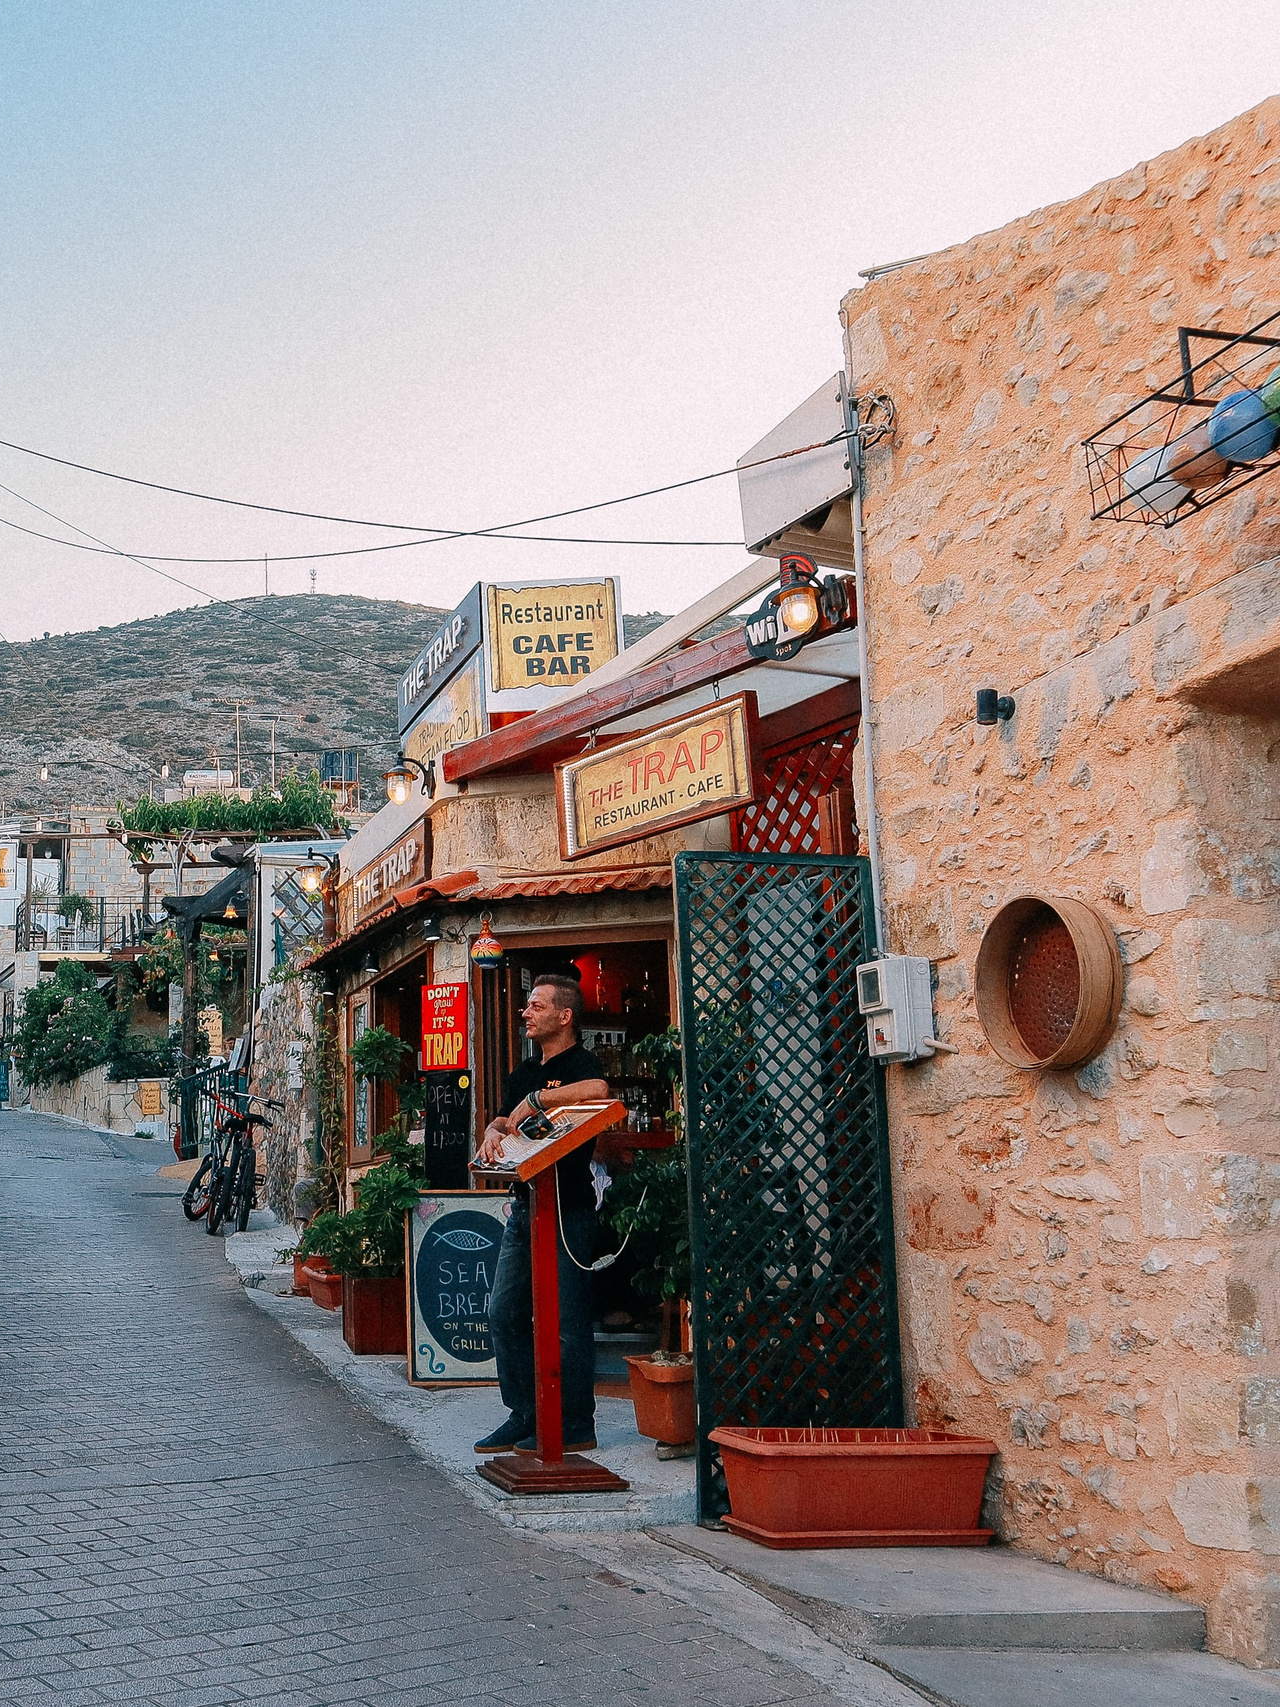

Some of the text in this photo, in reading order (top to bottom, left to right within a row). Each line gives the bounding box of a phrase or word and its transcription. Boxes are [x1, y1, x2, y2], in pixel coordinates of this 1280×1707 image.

[501, 598, 604, 625] Restaurant
[512, 632, 595, 655] CAFE
[775, 643, 793, 657] Spot
[402, 614, 463, 707] THE TRAP
[525, 655, 591, 677] BAR
[444, 709, 470, 749] FOOD
[588, 729, 724, 808] THE TRAP
[594, 790, 676, 829] RESTAURANT
[687, 773, 724, 798] CAFE
[356, 838, 417, 909] THE TRAP
[427, 986, 460, 1001] DON'T
[433, 999, 454, 1015] grow
[432, 1016, 455, 1029] IT'S
[423, 1032, 463, 1066] TRAP
[428, 1085, 467, 1113] OPEN
[439, 1113, 450, 1124] AT
[439, 1261, 490, 1289] SEA
[437, 1292, 491, 1319] BREA
[443, 1322, 489, 1332] ON THE
[451, 1335, 489, 1351] GRILL
